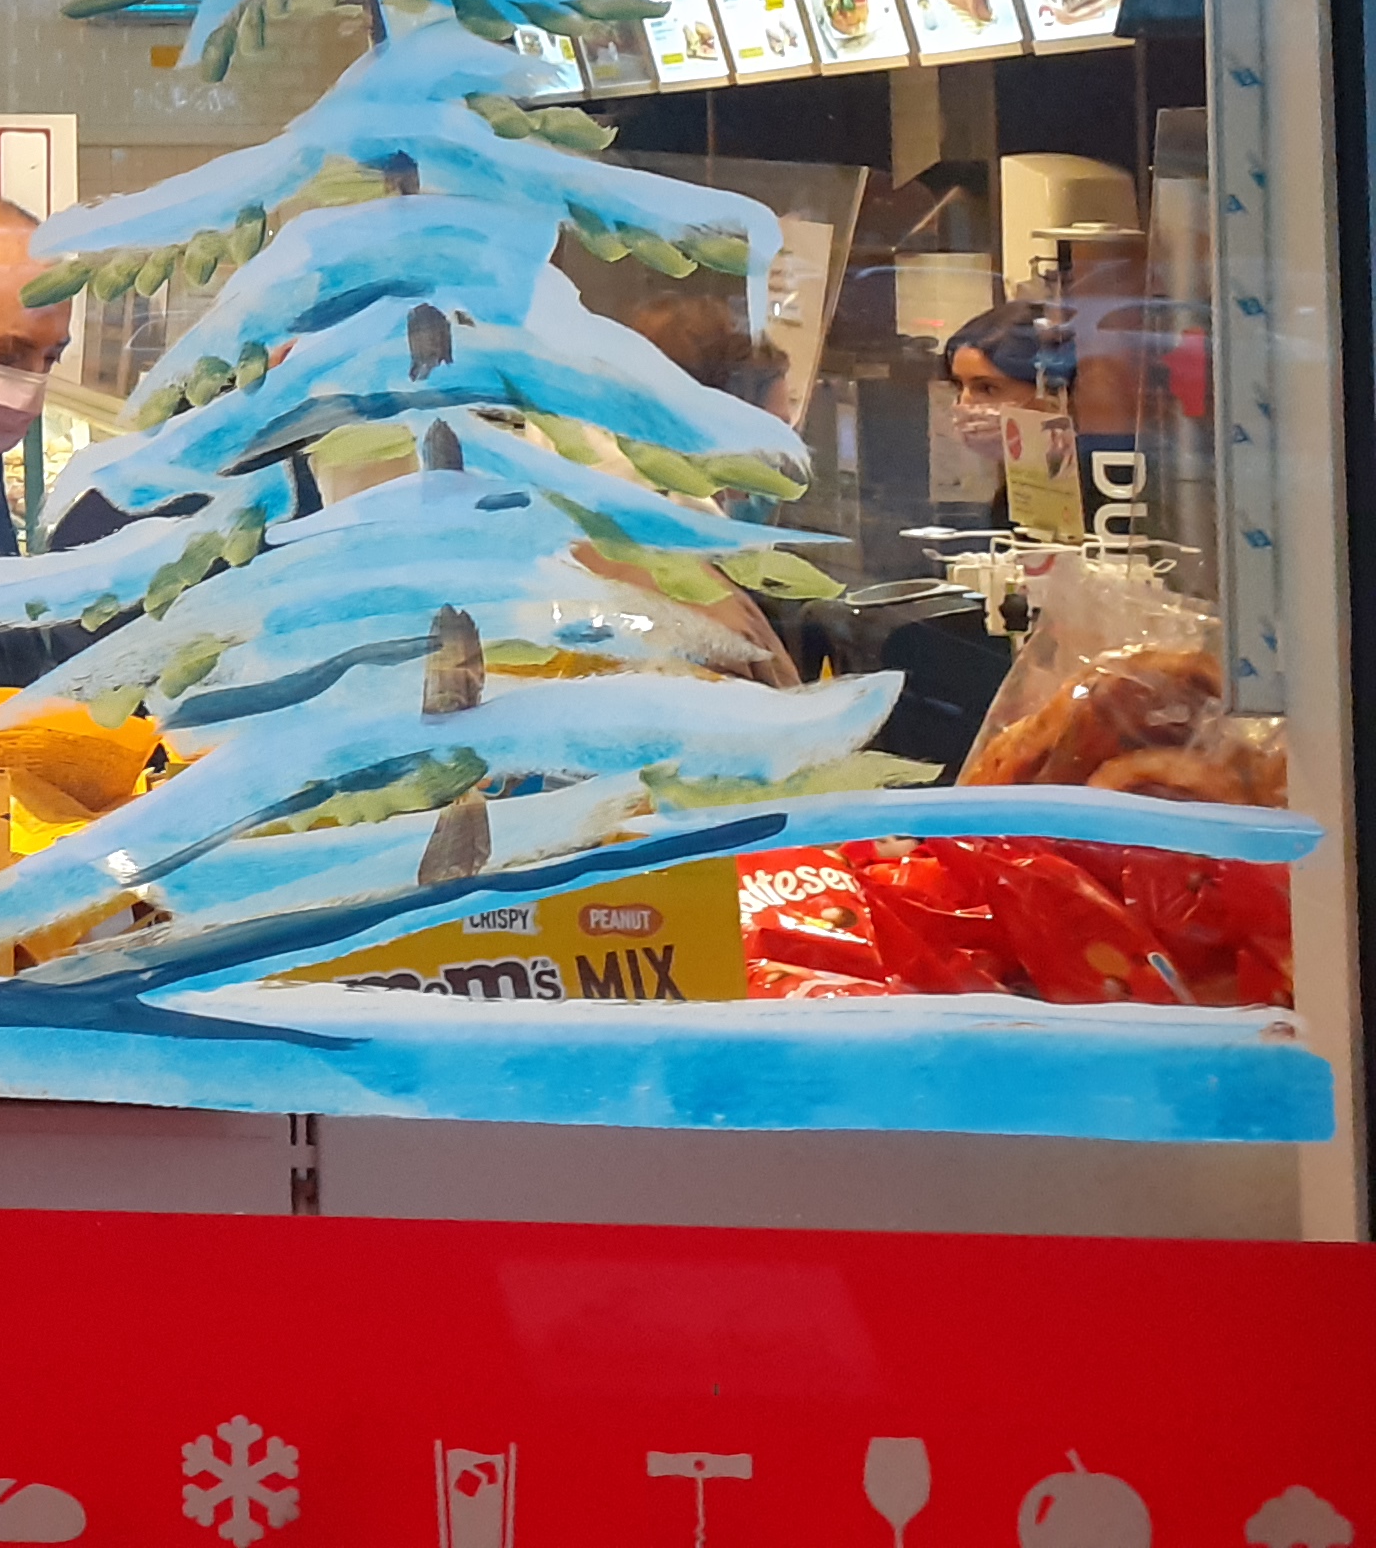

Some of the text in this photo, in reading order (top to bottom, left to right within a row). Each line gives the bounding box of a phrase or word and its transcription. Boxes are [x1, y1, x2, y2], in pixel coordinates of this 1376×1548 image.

[467, 908, 529, 931] CRISPY
[588, 909, 653, 931] PEANUT
[575, 944, 687, 1002] MIX
